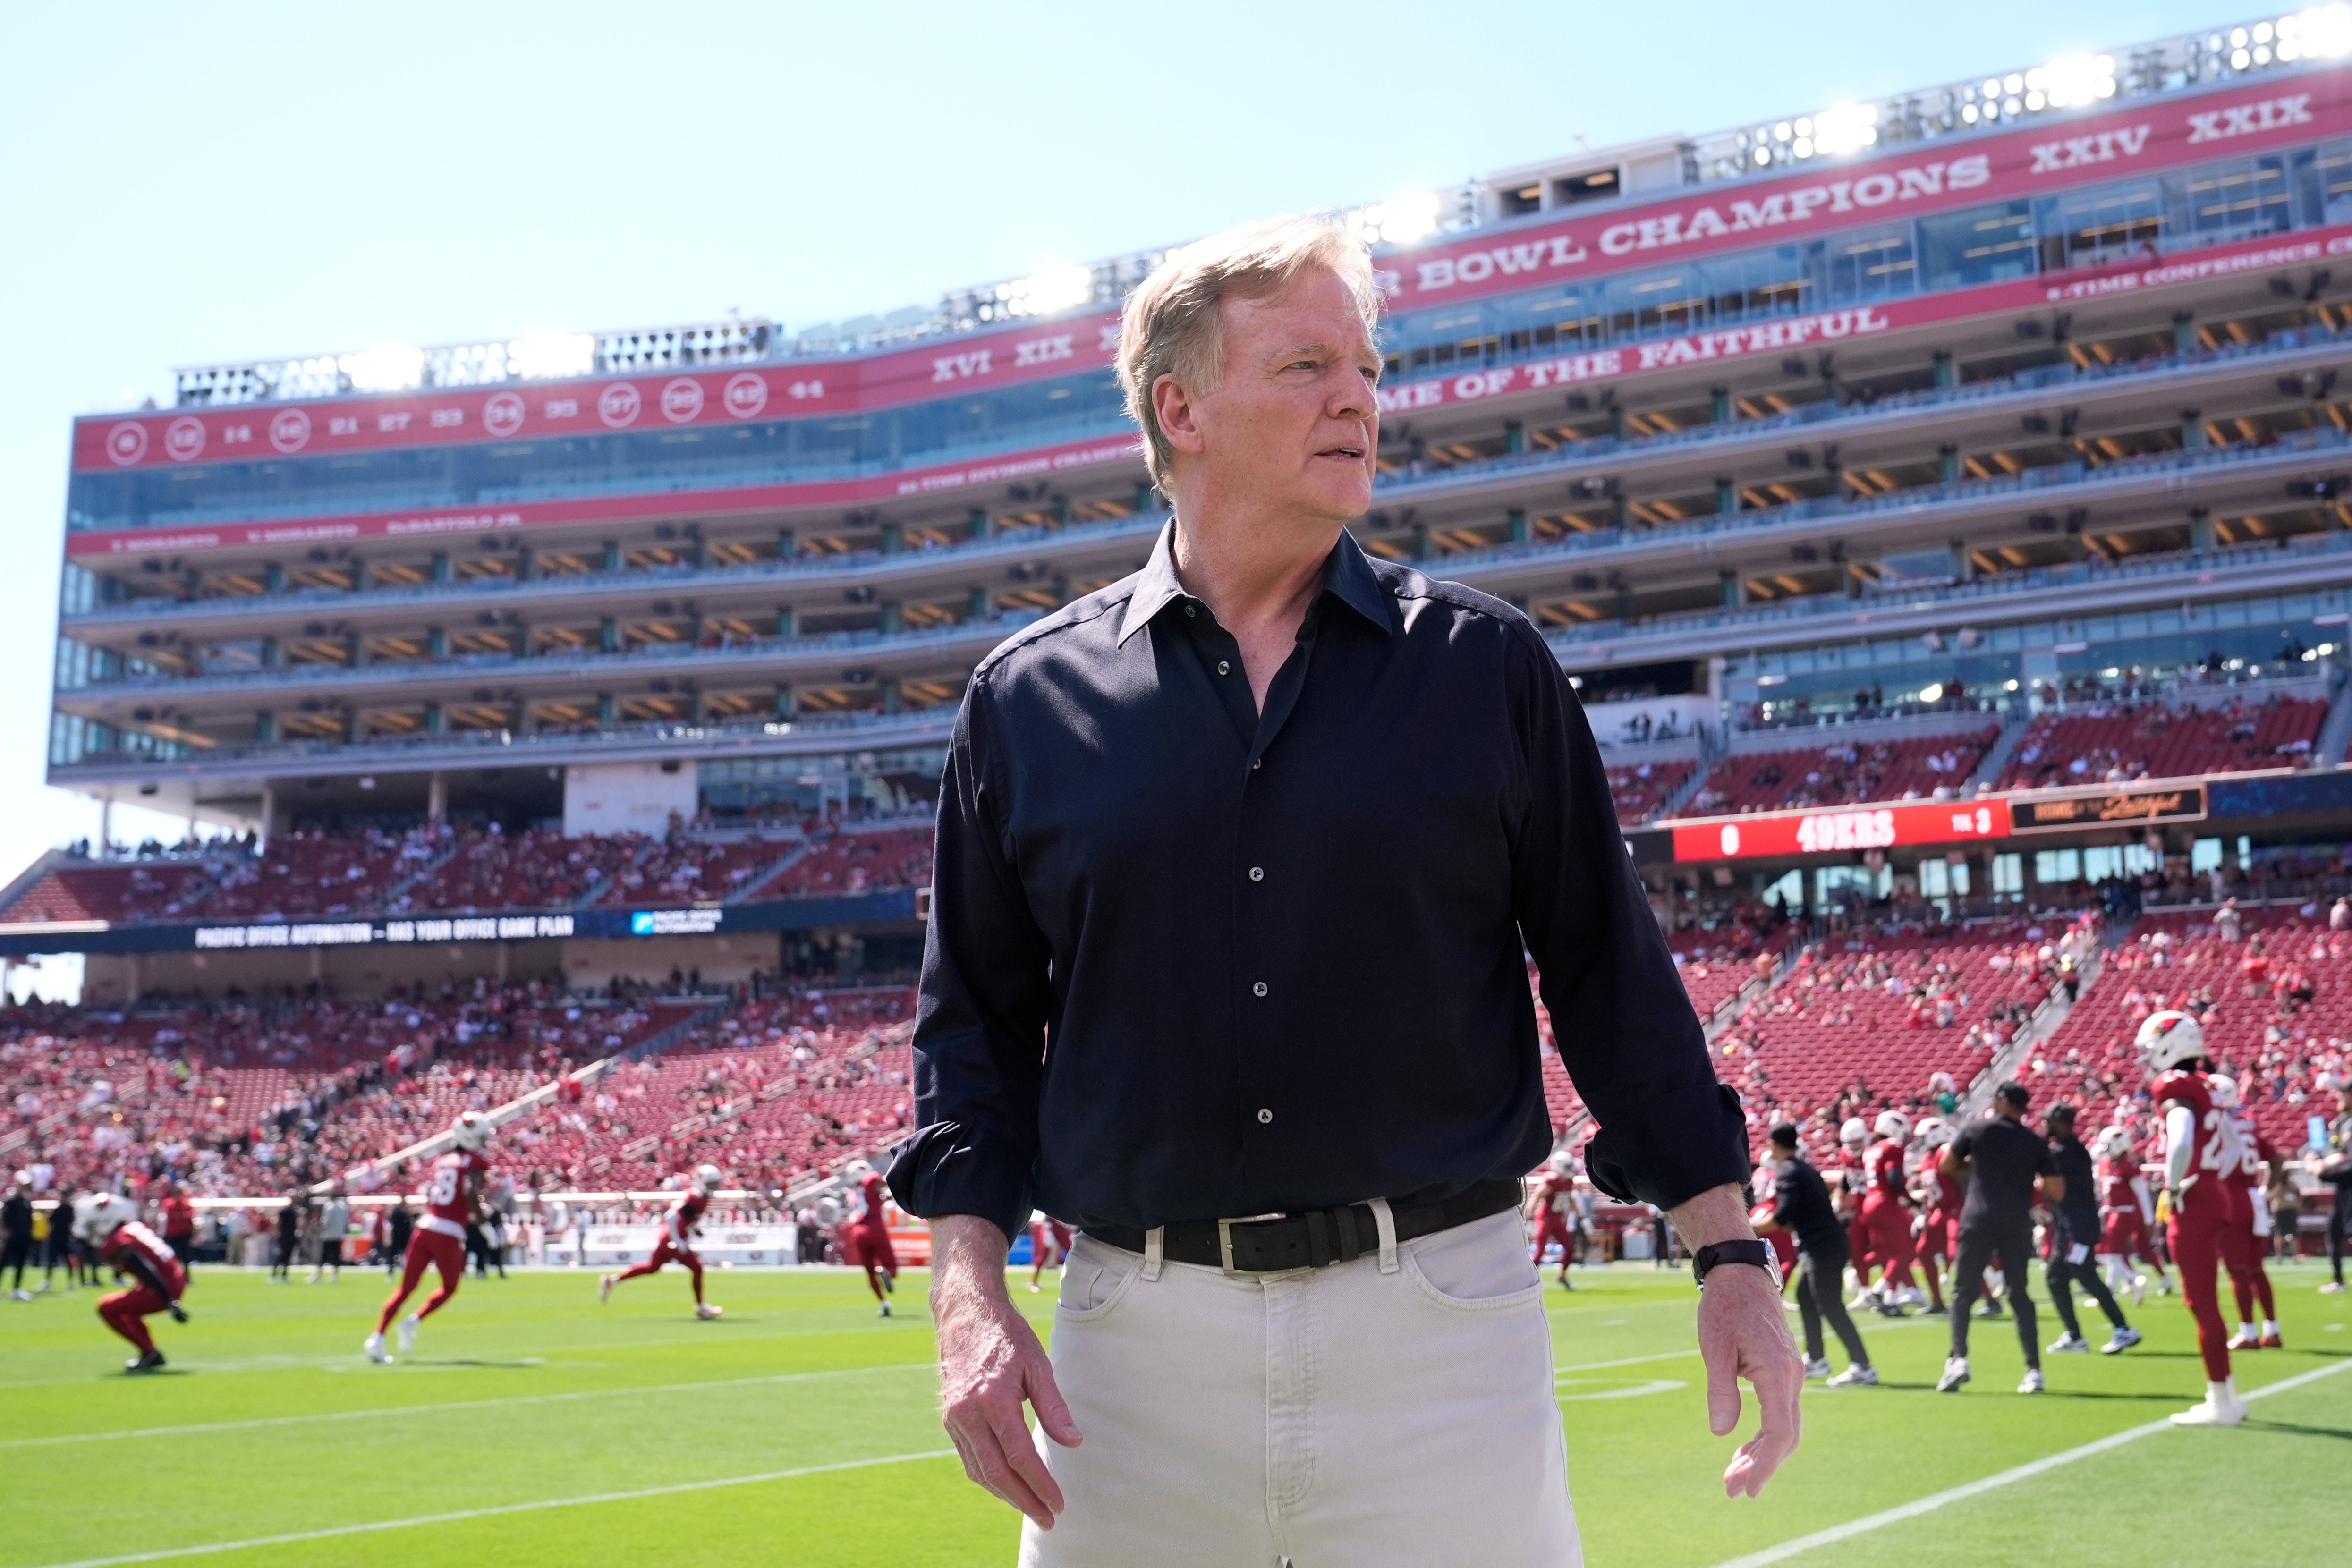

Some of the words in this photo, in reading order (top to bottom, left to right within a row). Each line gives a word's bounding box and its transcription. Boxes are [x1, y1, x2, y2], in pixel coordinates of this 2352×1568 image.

[2187, 94, 2313, 144] XXIX
[2030, 124, 2151, 174] XXIV
[1418, 235, 1587, 290] BOWL
[1599, 154, 1990, 255] CHAMPIONS
[2143, 241, 2322, 286] CONFERENCE
[932, 349, 993, 383] XVI
[1014, 334, 1074, 368] XIX
[1377, 381, 1443, 413] ME
[1454, 367, 1514, 400] OF
[1524, 350, 1623, 388] THE
[1638, 307, 1888, 369] FAITHFUL
[1721, 824, 1740, 855] 0
[1797, 809, 1895, 852] 49ERS
[1975, 807, 1992, 834] 3
[2200, 1109, 2221, 1170] 2
[2240, 1133, 2260, 1175] 6
